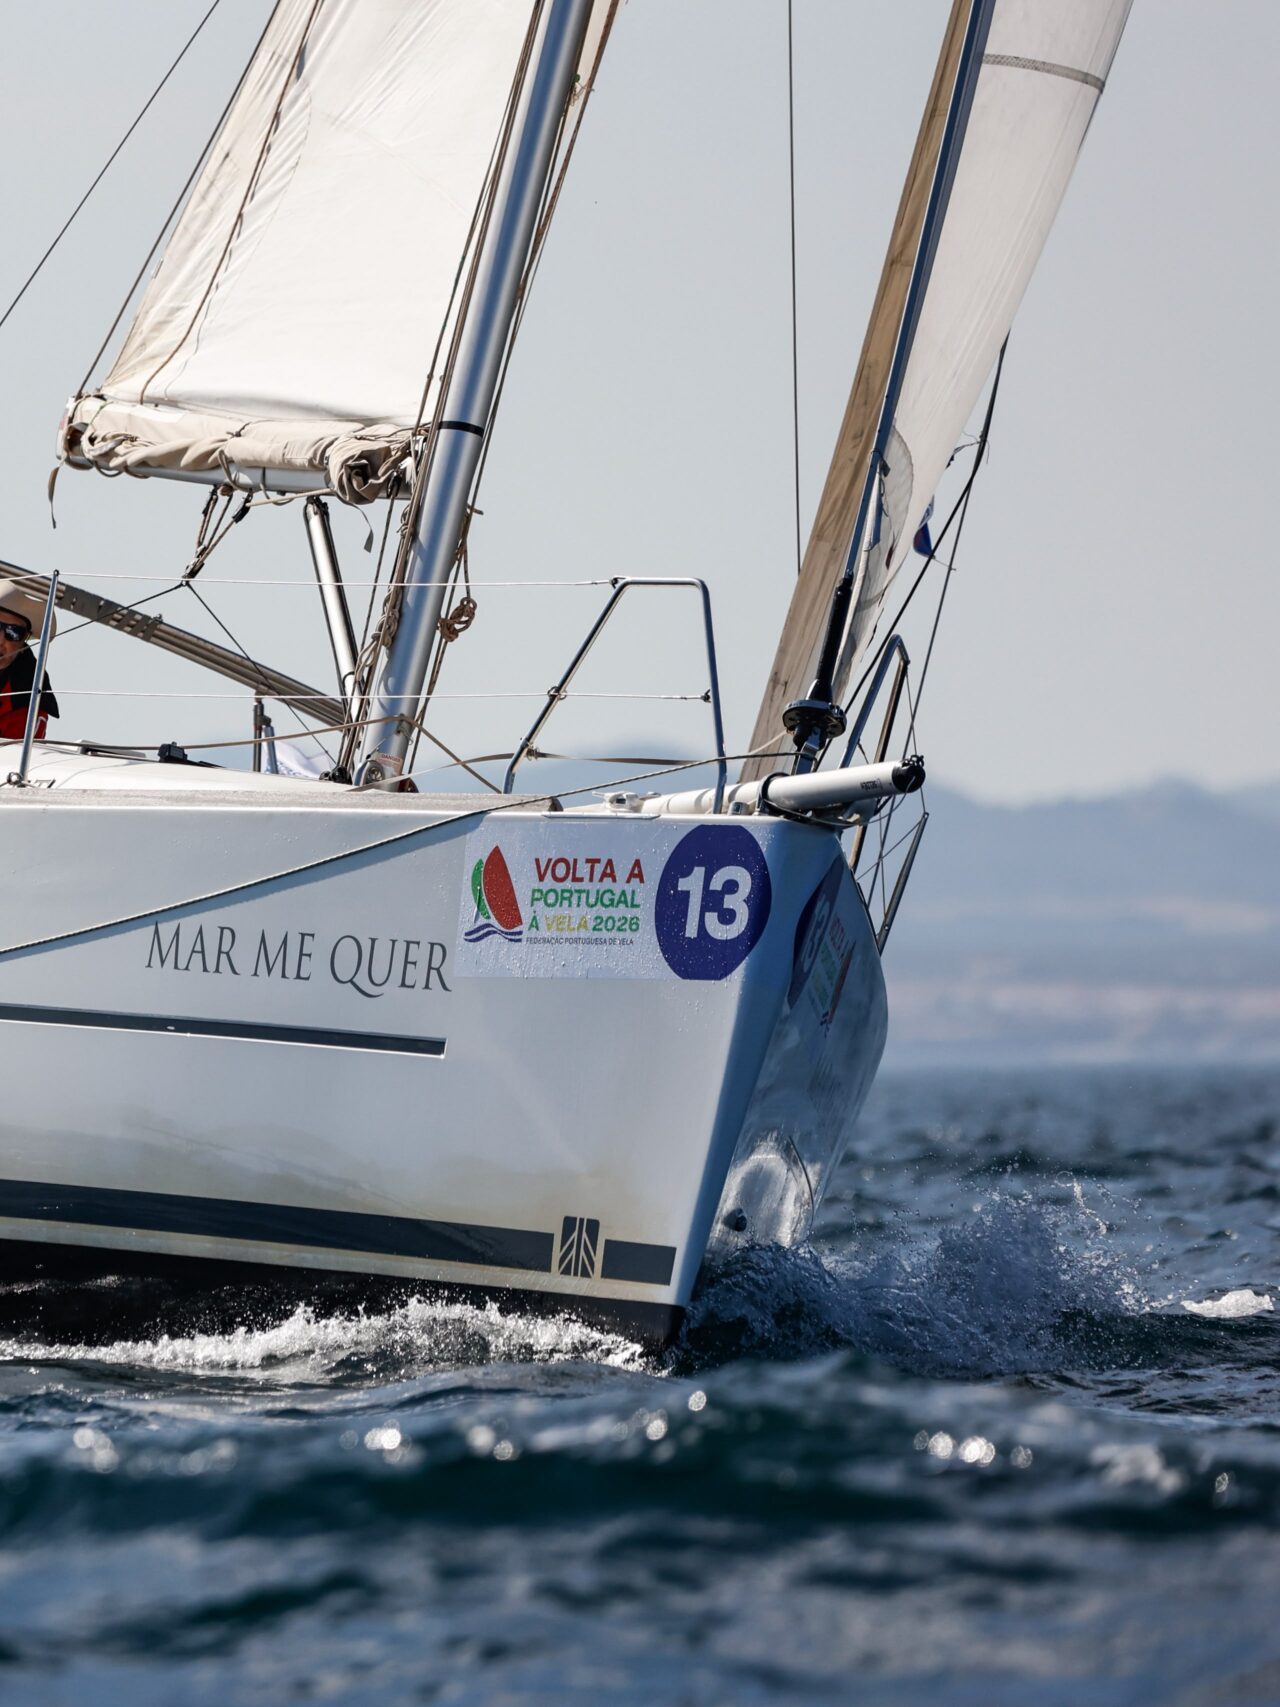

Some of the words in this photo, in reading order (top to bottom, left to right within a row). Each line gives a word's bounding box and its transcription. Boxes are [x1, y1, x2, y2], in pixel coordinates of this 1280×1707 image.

[534, 857, 617, 884] VOLTA
[625, 858, 645, 884] A
[530, 888, 641, 909] PORTUGAL
[677, 865, 752, 941] 13
[545, 914, 589, 932] VELA
[591, 915, 641, 933] 2026
[565, 937, 607, 946] PORTUGUESA
[608, 938, 618, 946] DE
[618, 938, 634, 946] VELA
[145, 920, 241, 976] MAR
[251, 928, 316, 981] ME
[329, 934, 453, 999] QUER
